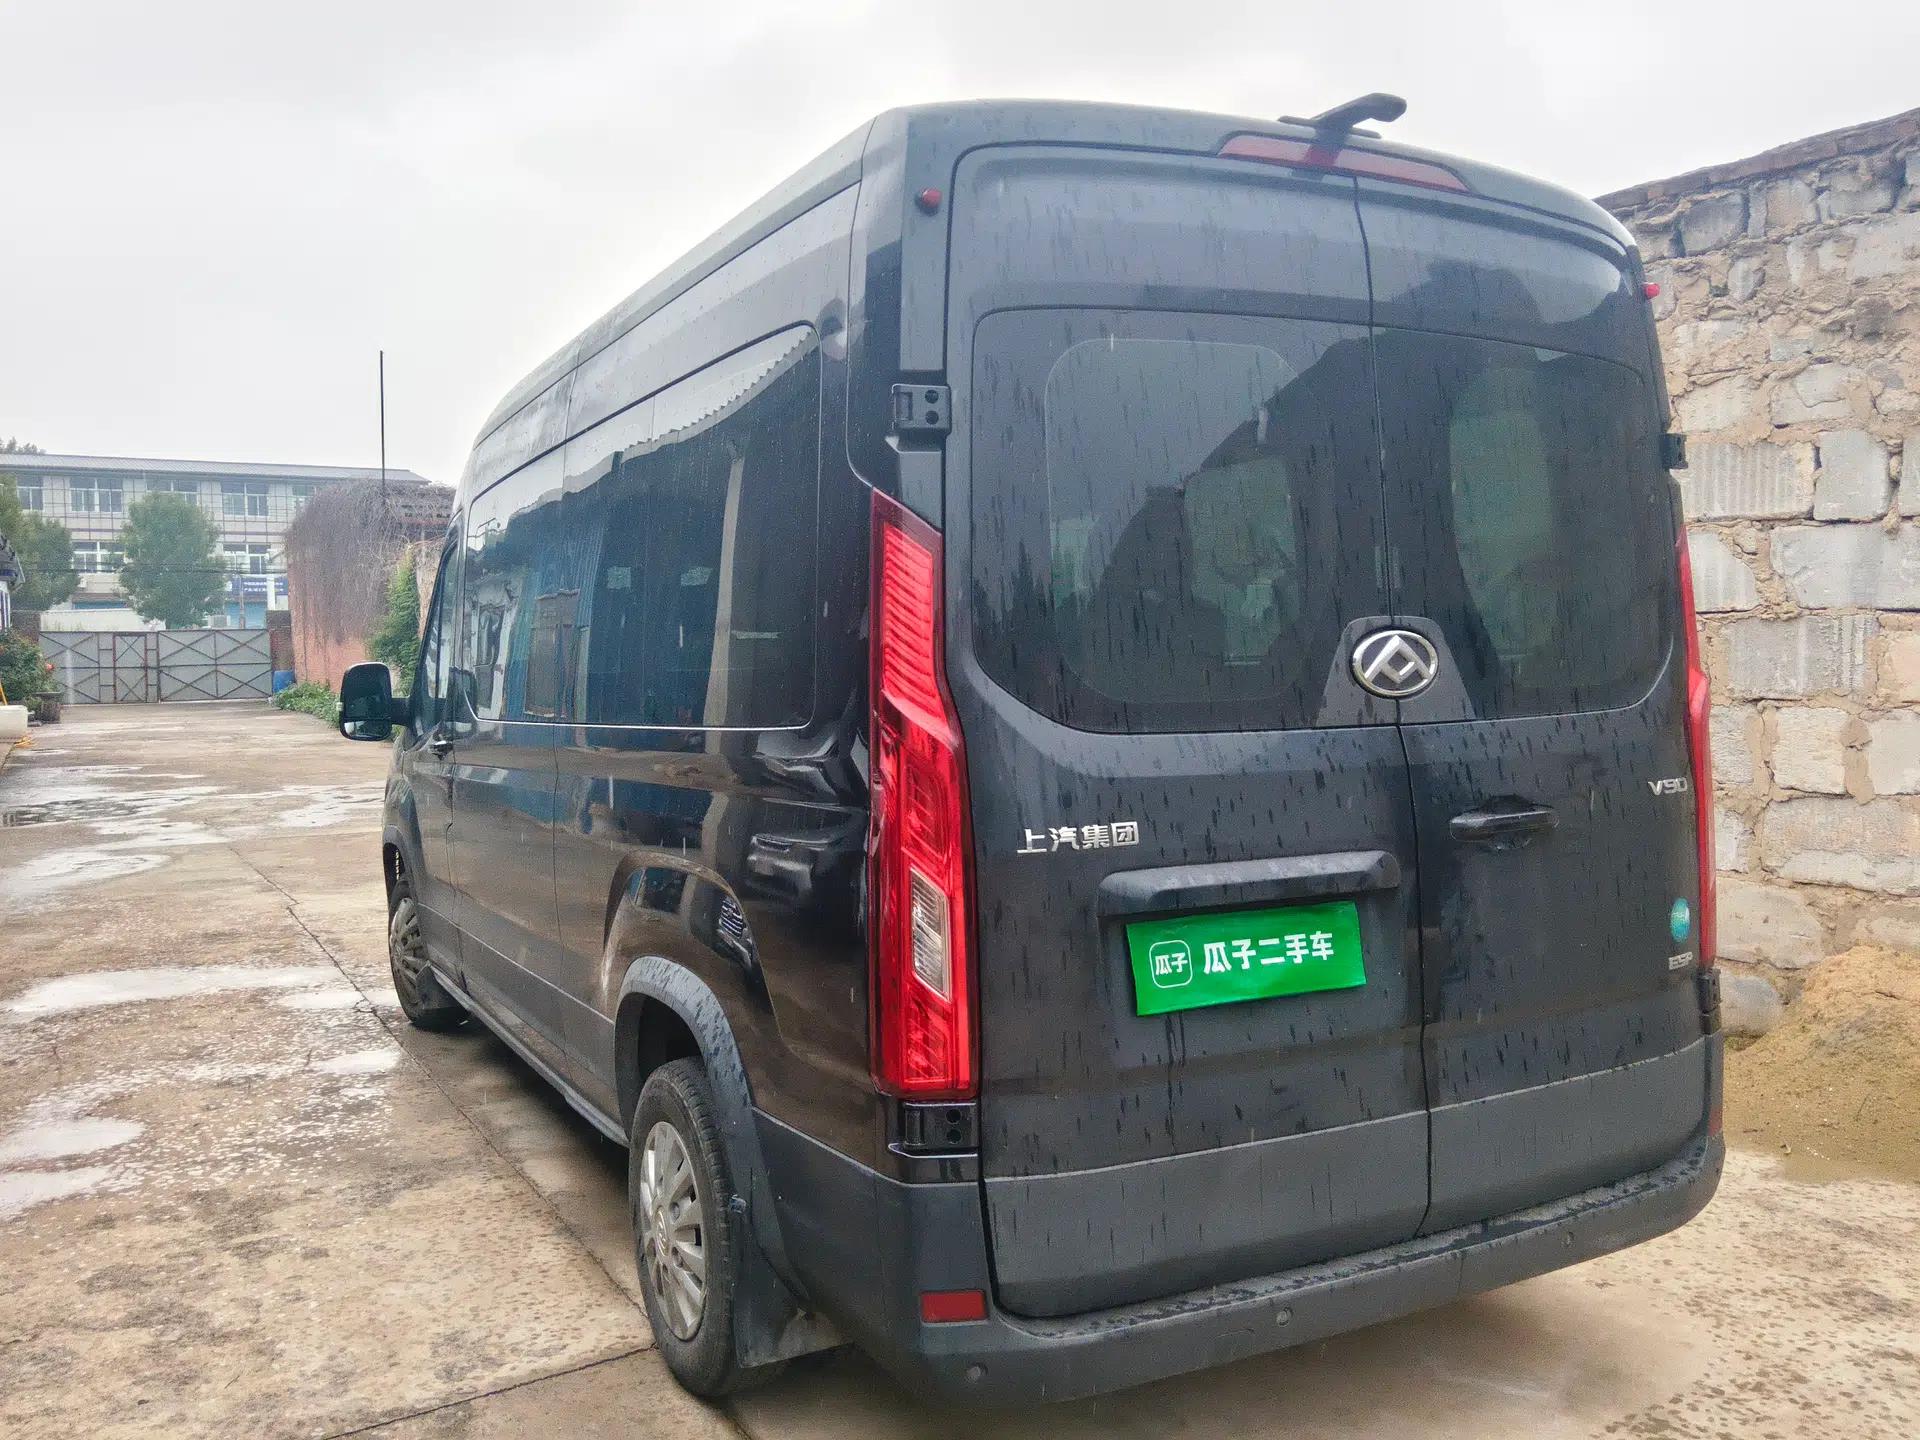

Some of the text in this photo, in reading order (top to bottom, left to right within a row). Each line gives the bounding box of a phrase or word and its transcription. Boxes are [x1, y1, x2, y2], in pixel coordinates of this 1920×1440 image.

[1648, 777, 1688, 796] V90
[1017, 821, 1140, 854] 上汽集团
[1155, 952, 1189, 976] 瓜子
[1203, 930, 1335, 974] 瓜子二手车
